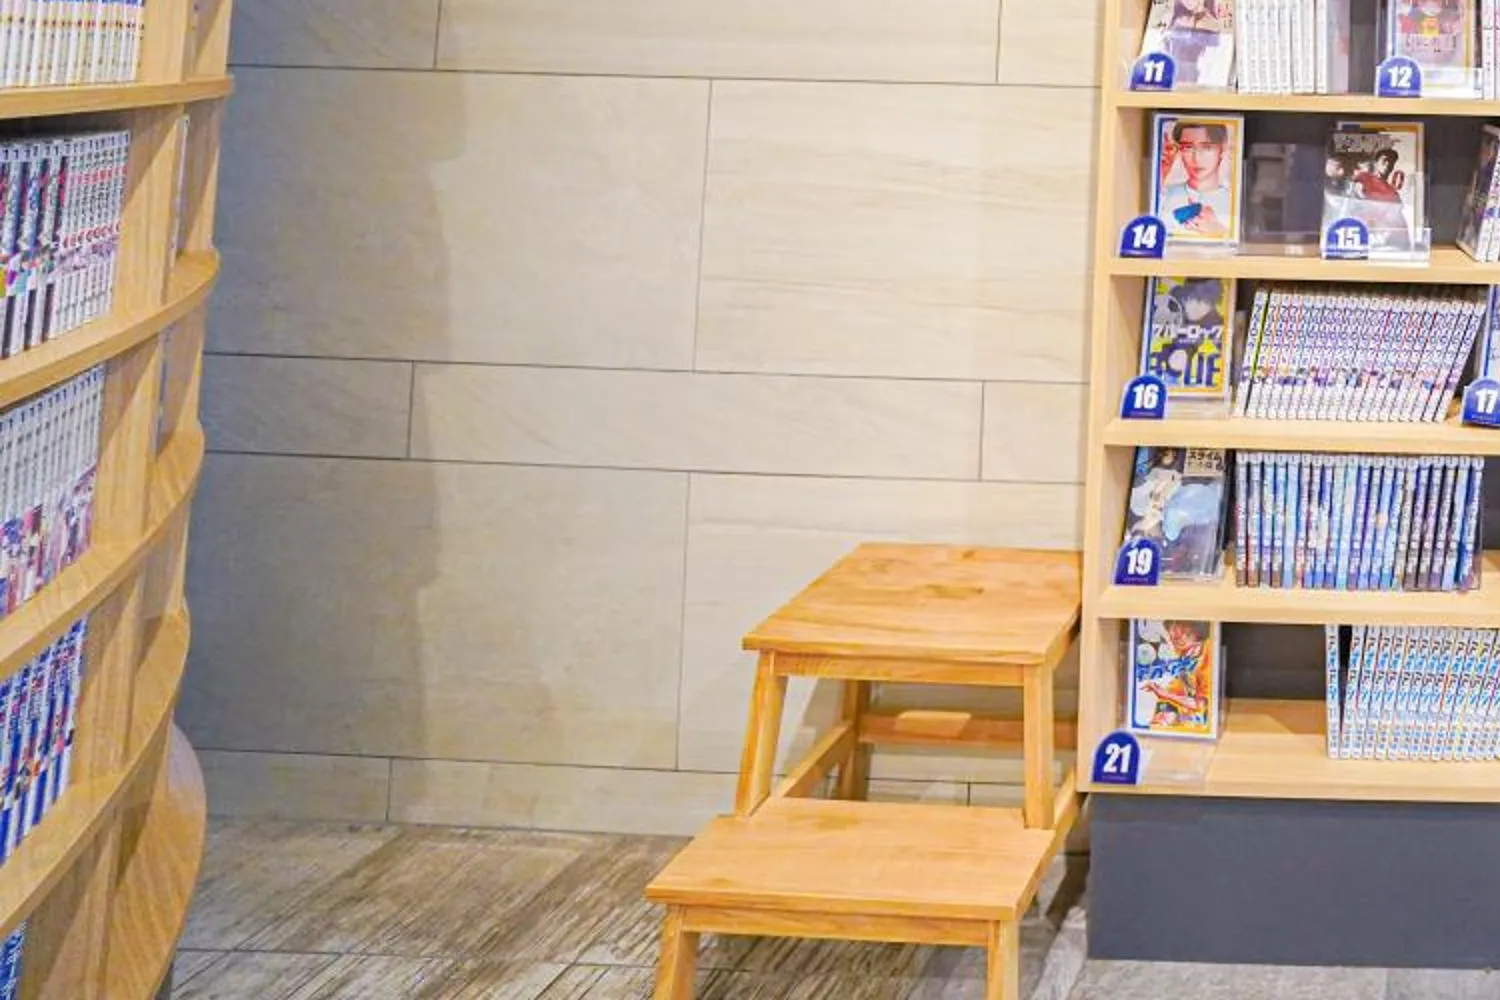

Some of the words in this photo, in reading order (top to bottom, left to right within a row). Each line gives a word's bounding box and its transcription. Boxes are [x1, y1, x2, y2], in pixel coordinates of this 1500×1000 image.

[1143, 59, 1166, 83] 11
[1387, 66, 1411, 88] 12
[1132, 225, 1158, 249] 14
[1335, 226, 1362, 249] 15
[1133, 383, 1159, 409] 16
[1475, 389, 1497, 413] 17
[1126, 547, 1151, 575] 19
[1103, 743, 1131, 774] 21
